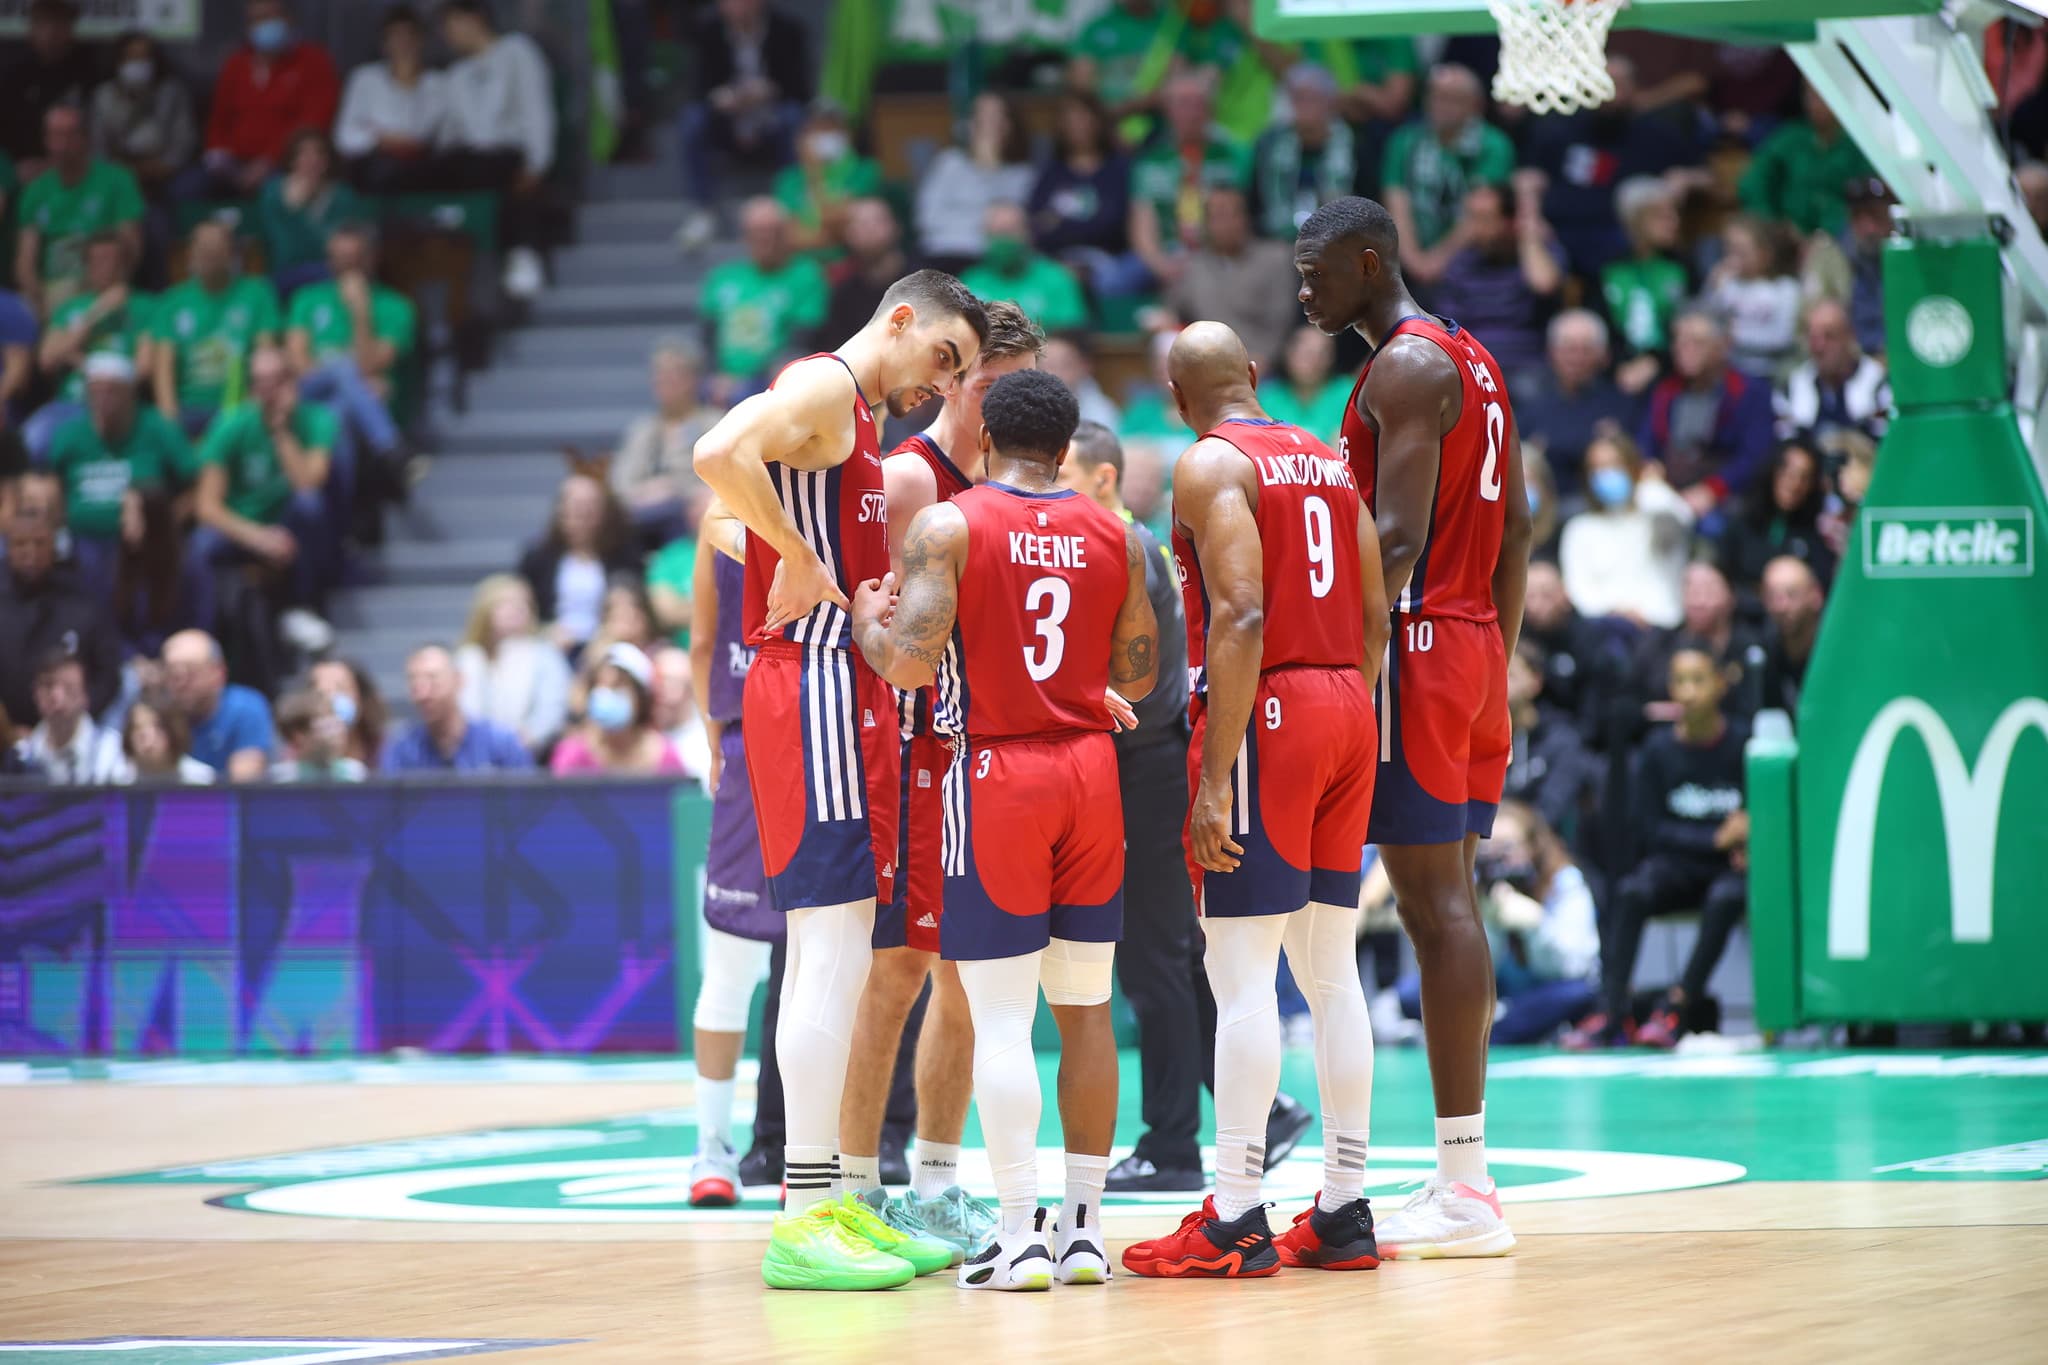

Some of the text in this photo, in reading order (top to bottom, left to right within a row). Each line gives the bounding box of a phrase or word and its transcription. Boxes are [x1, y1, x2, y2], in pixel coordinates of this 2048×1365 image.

[1008, 531, 1087, 568] KEENE
[1303, 495, 1335, 599] 9
[1877, 519, 2020, 564] Betclic
[1023, 576, 1071, 682] 3
[1406, 620, 1433, 652] 10
[1265, 696, 1282, 730] 9
[976, 749, 992, 779] 3
